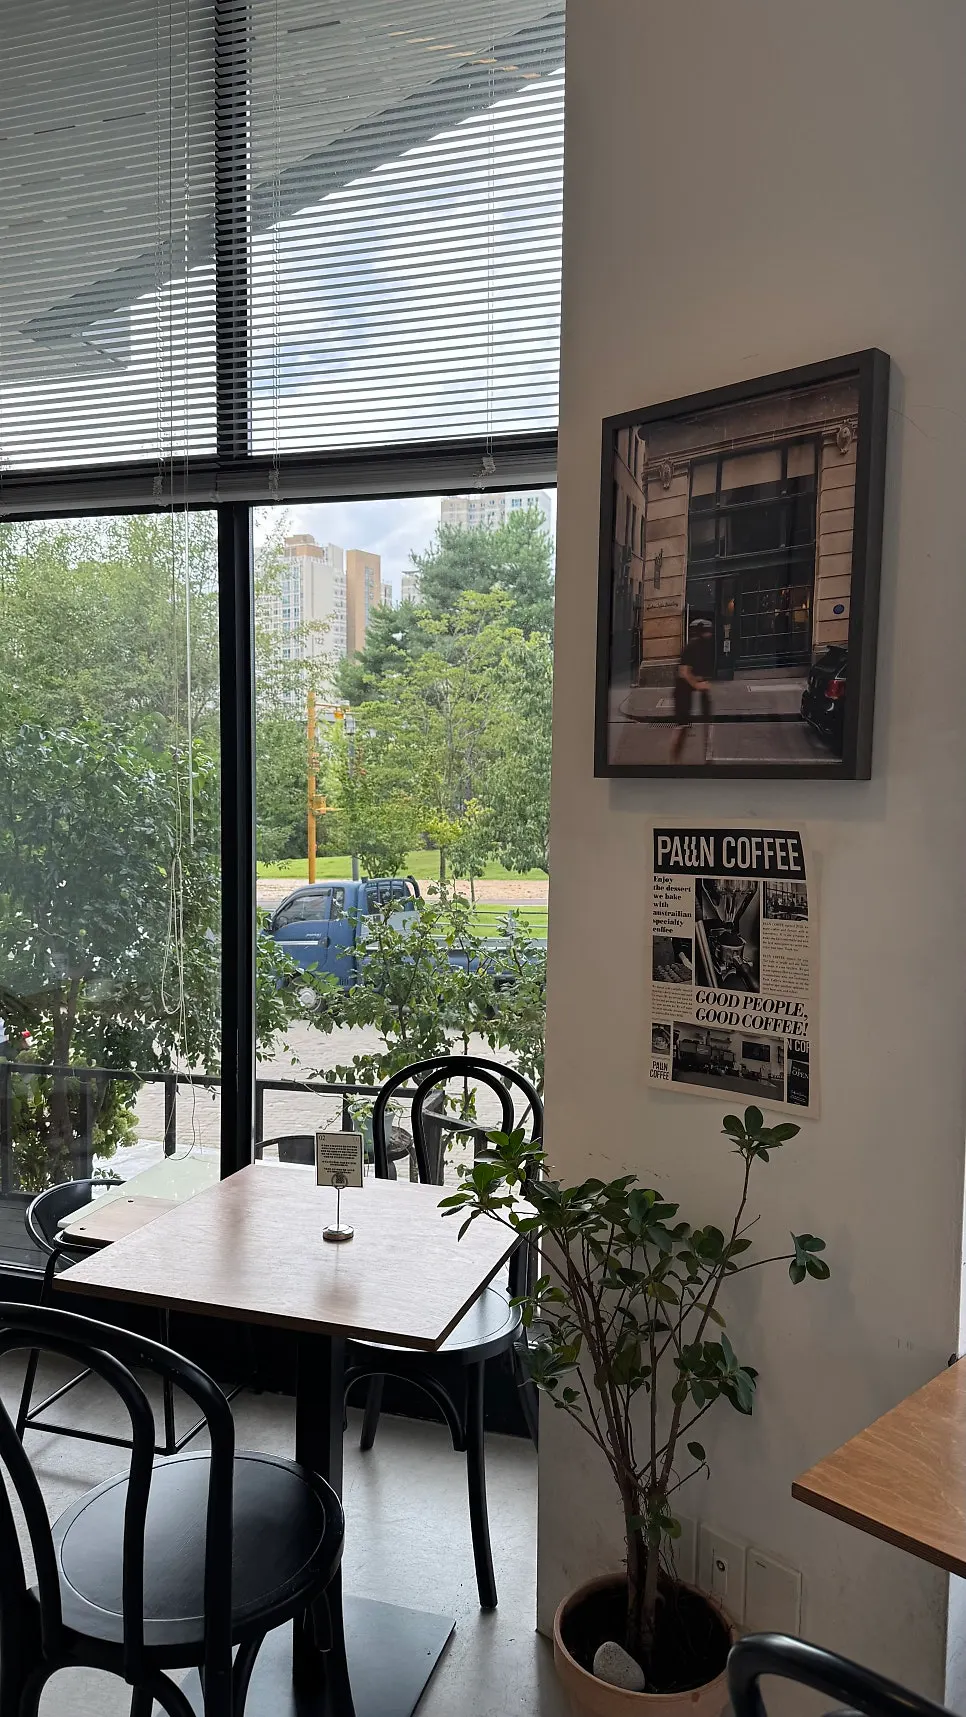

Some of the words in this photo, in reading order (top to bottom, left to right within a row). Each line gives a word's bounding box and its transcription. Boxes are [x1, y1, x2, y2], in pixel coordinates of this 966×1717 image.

[722, 836, 801, 871] COFFEE
[653, 876, 673, 884] Enjoy
[695, 990, 740, 1008] GOOD
[742, 996, 808, 1021] PEOPLE,
[695, 1008, 740, 1026] GOOD
[741, 1014, 808, 1037] COFFEE!
[649, 1069, 670, 1081] COFFEE
